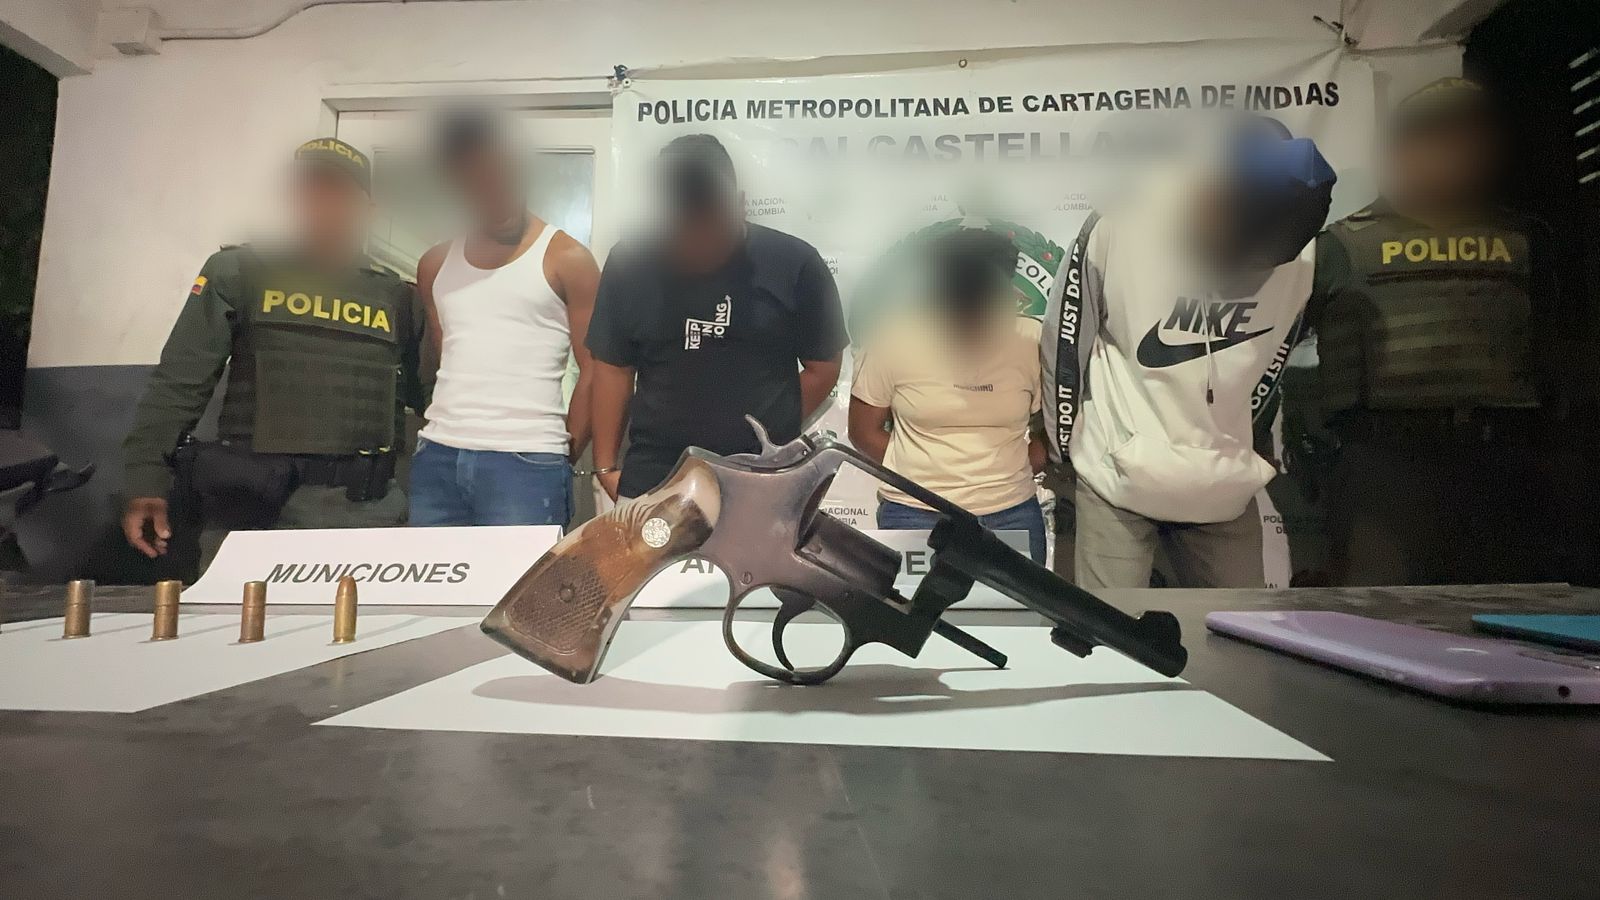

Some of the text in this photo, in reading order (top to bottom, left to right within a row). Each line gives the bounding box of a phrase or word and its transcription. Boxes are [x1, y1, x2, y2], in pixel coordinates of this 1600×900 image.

[637, 81, 1340, 125] POLICIA METROPOLITANA DE CARTAGENA DE INDIAS
[1381, 236, 1512, 265] POLICIA
[1067, 268, 1080, 299] DO
[262, 289, 391, 334] POLICIA
[1061, 301, 1078, 344] JUST
[1163, 296, 1258, 338] NIKE
[1058, 384, 1073, 399] IT
[1059, 402, 1073, 425] DO
[264, 562, 471, 584] MUNICIONES
